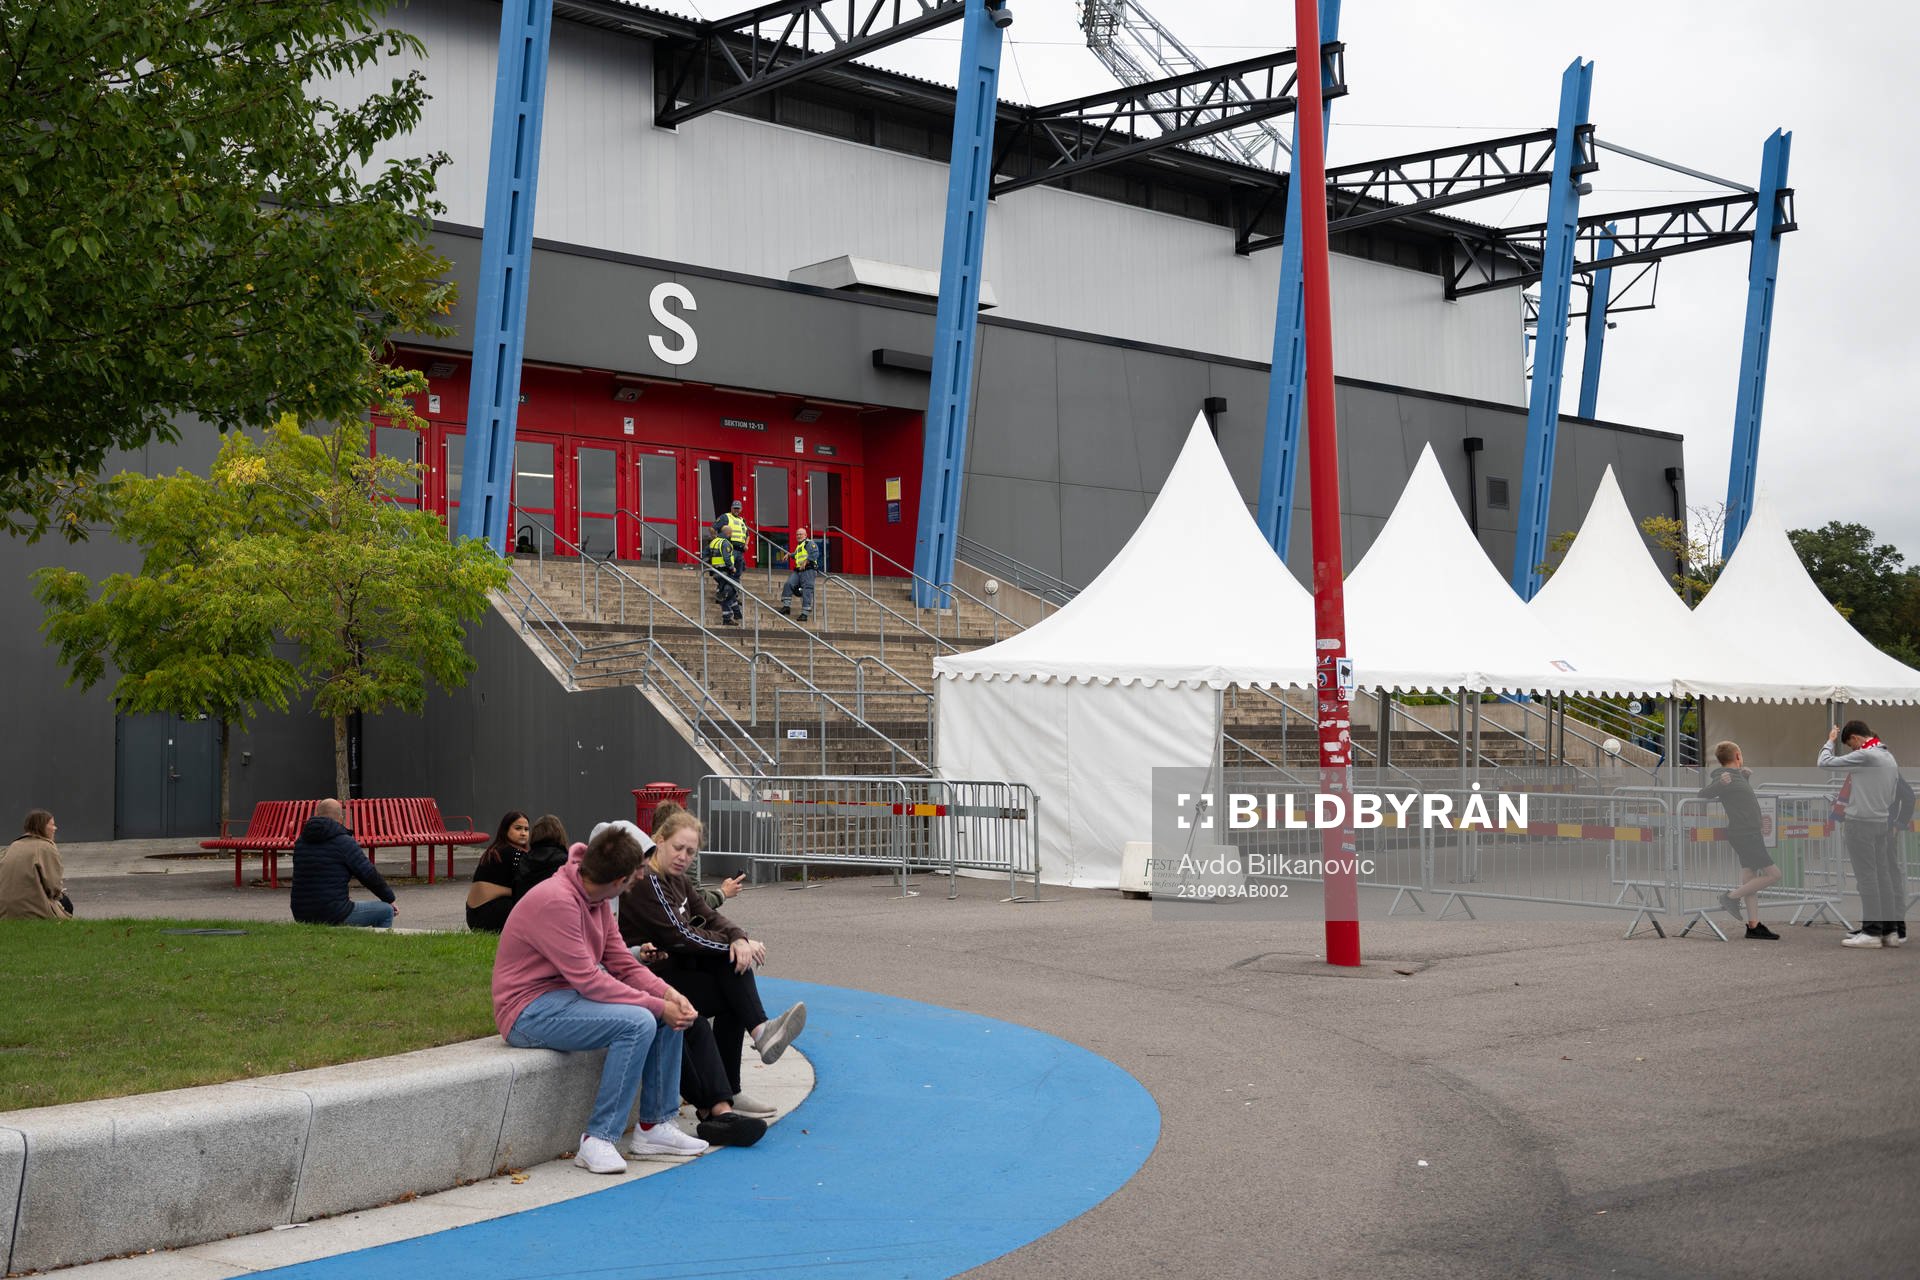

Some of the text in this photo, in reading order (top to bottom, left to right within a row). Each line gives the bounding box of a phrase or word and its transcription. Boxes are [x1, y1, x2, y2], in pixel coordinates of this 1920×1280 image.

[648, 281, 698, 366] S
[724, 419, 764, 431] SEKTION 12-13
